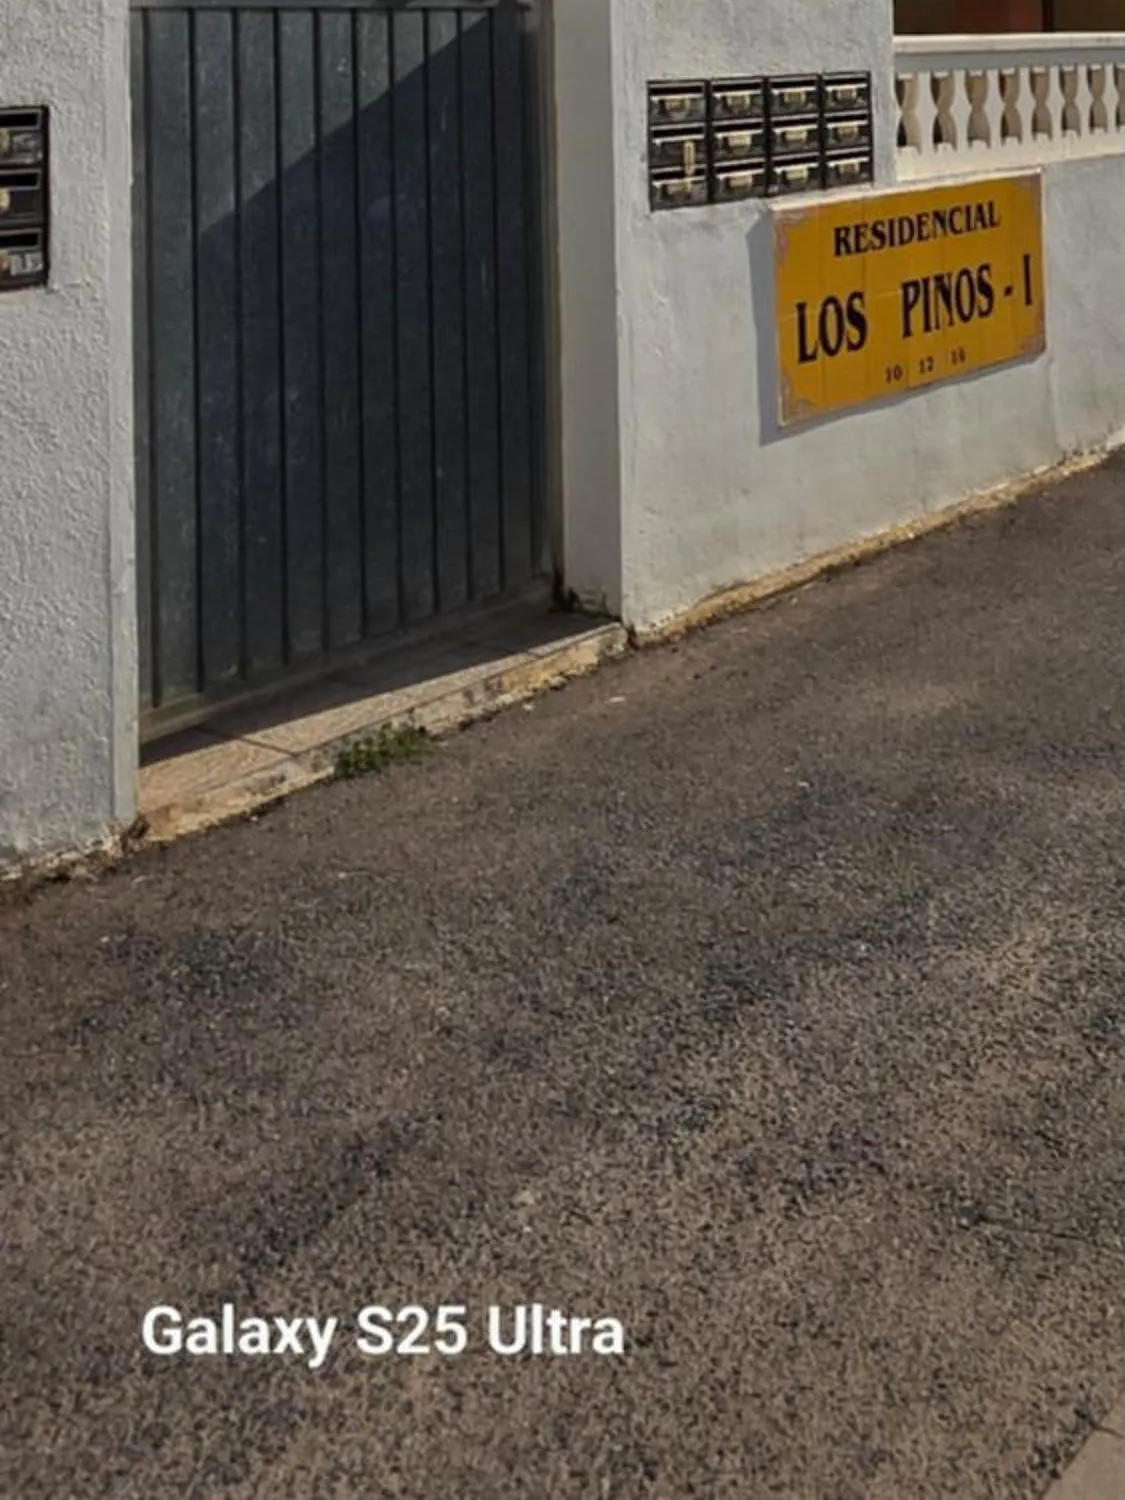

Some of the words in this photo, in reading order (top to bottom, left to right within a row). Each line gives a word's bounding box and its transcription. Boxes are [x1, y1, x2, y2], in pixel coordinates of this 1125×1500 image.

[833, 201, 999, 257] RESIDENCIAL
[796, 290, 868, 366] LOS
[885, 364, 904, 385] 10
